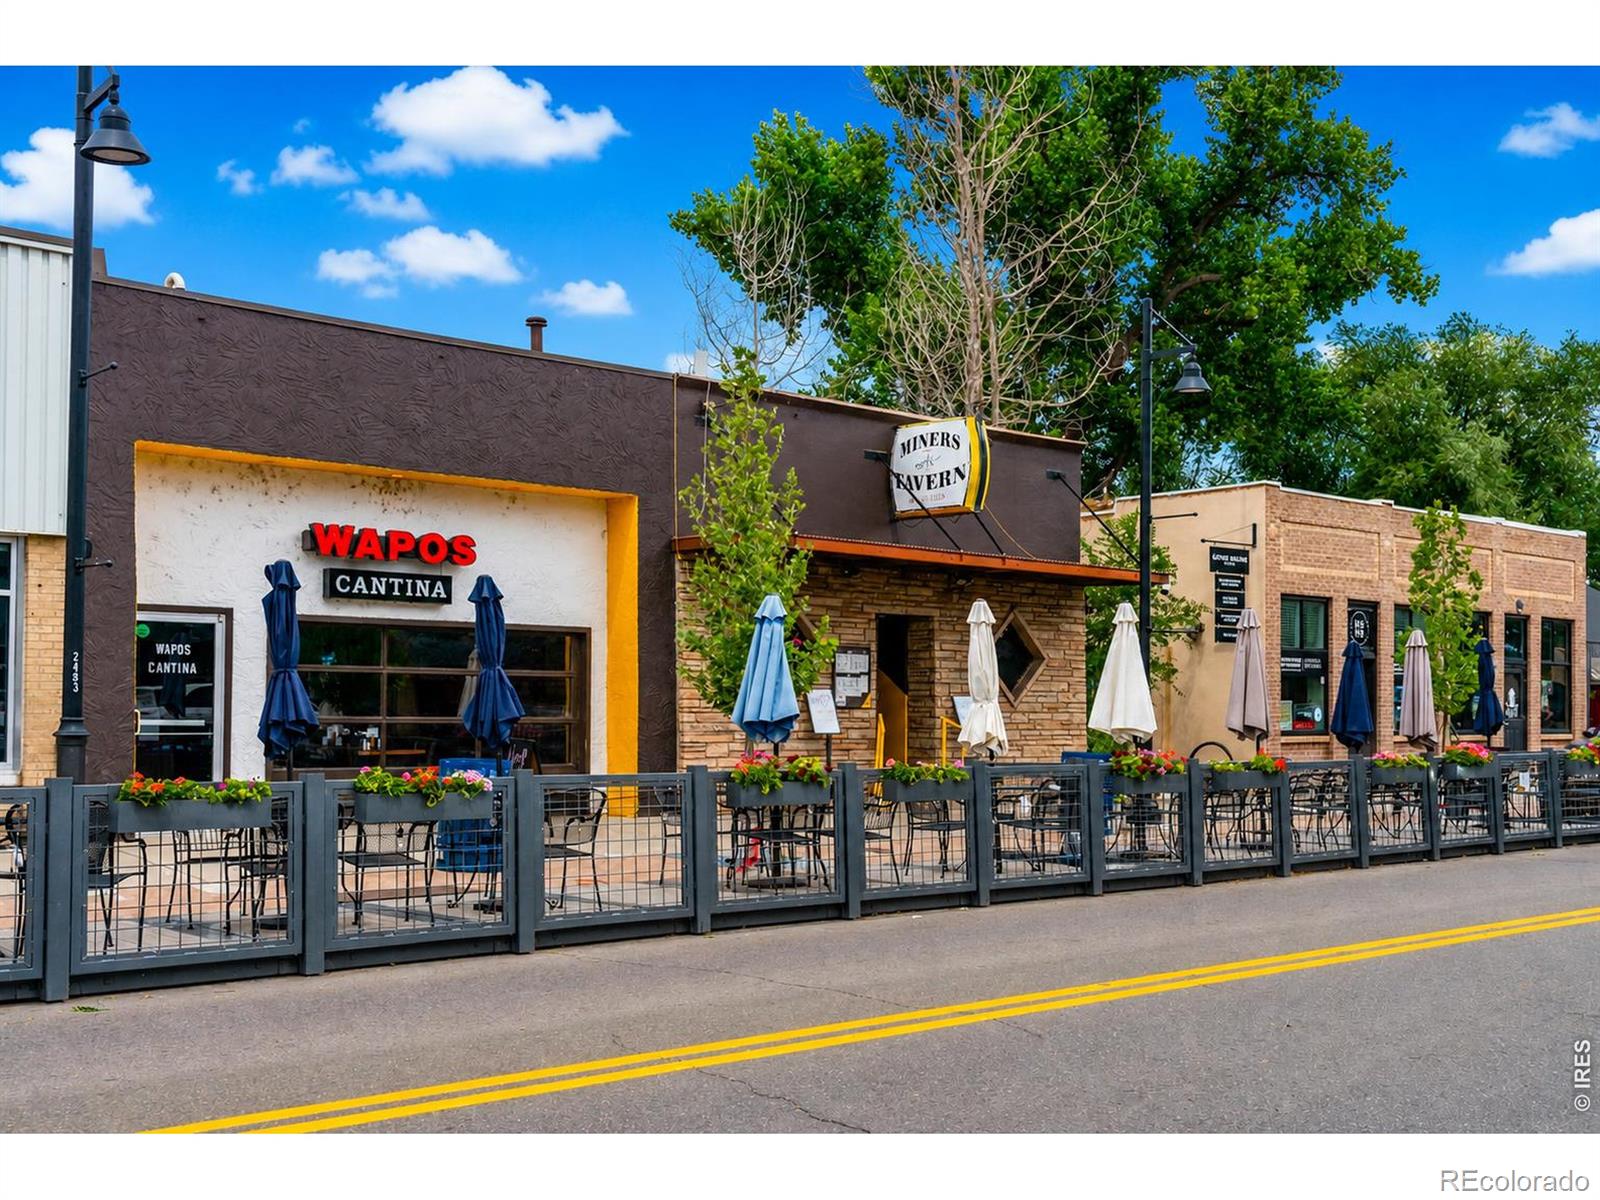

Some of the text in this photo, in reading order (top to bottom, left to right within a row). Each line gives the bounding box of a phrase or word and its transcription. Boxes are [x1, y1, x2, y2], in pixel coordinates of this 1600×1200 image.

[900, 431, 961, 459] MINERS
[894, 463, 967, 491] TAVERN
[311, 522, 478, 567] WAPOS
[335, 574, 448, 599] CANTINA
[155, 643, 192, 656] WAPOS
[148, 661, 198, 675] CANTINA
